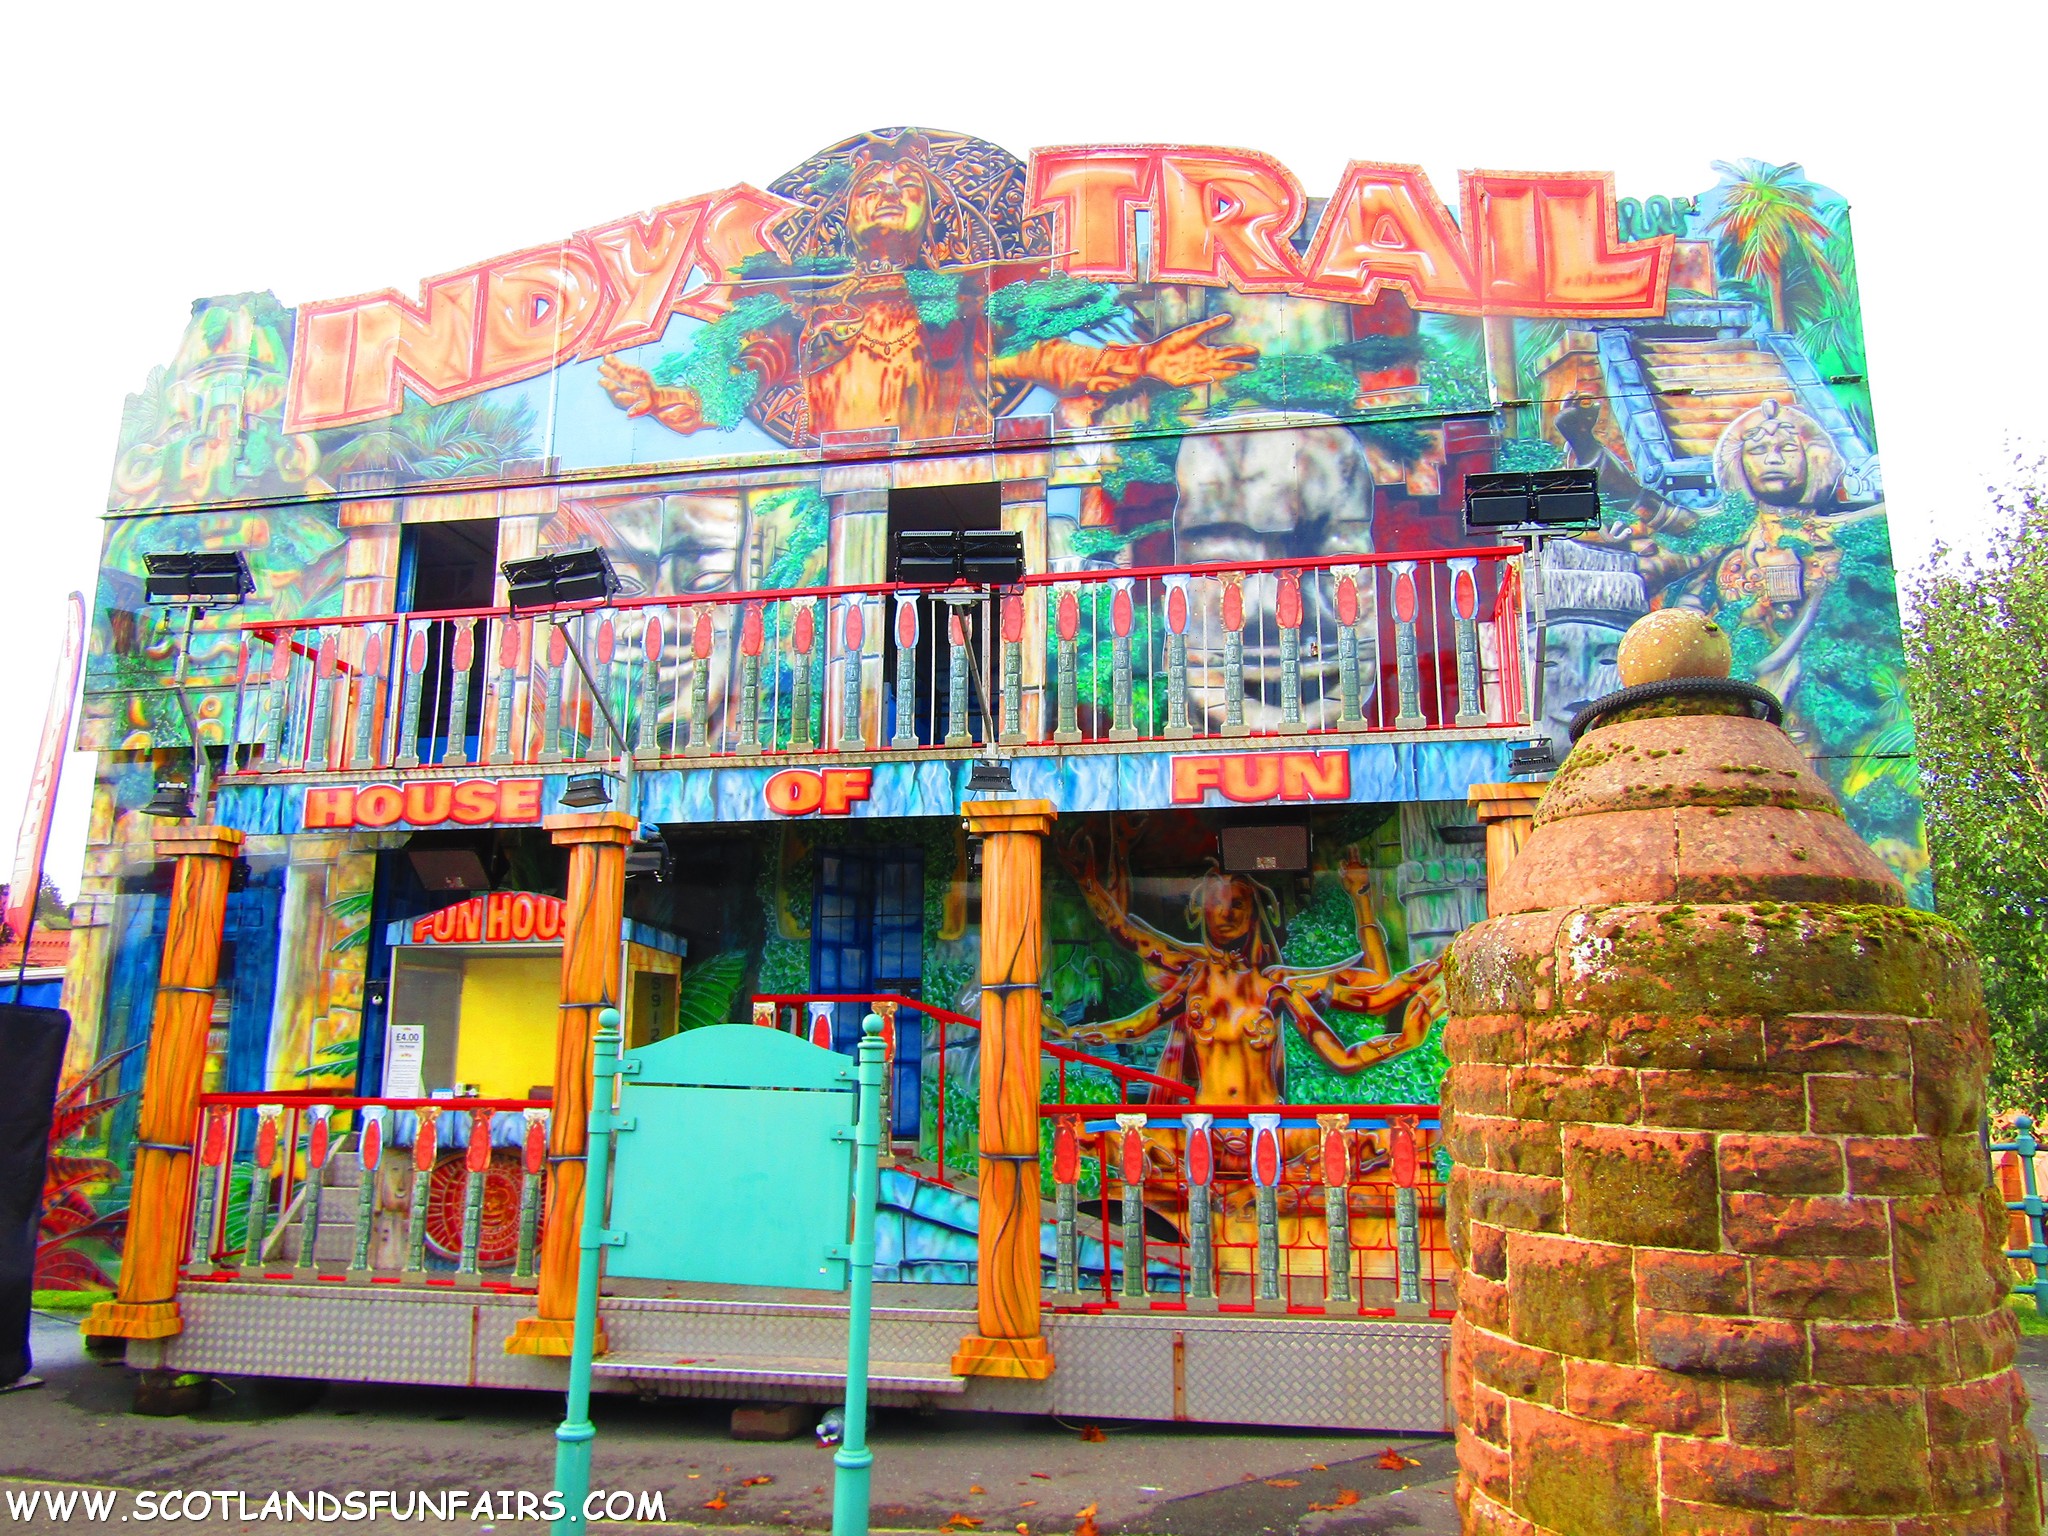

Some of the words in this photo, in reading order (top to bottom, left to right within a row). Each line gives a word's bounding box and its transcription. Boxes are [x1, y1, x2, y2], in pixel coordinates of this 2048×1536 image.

[1022, 143, 1676, 319] TRAIL
[303, 778, 544, 829] HOUSE
[763, 767, 873, 815] OF
[1169, 749, 1350, 804] FUN
[412, 895, 485, 943] FUN
[396, 1033, 420, 1042] £4.00
